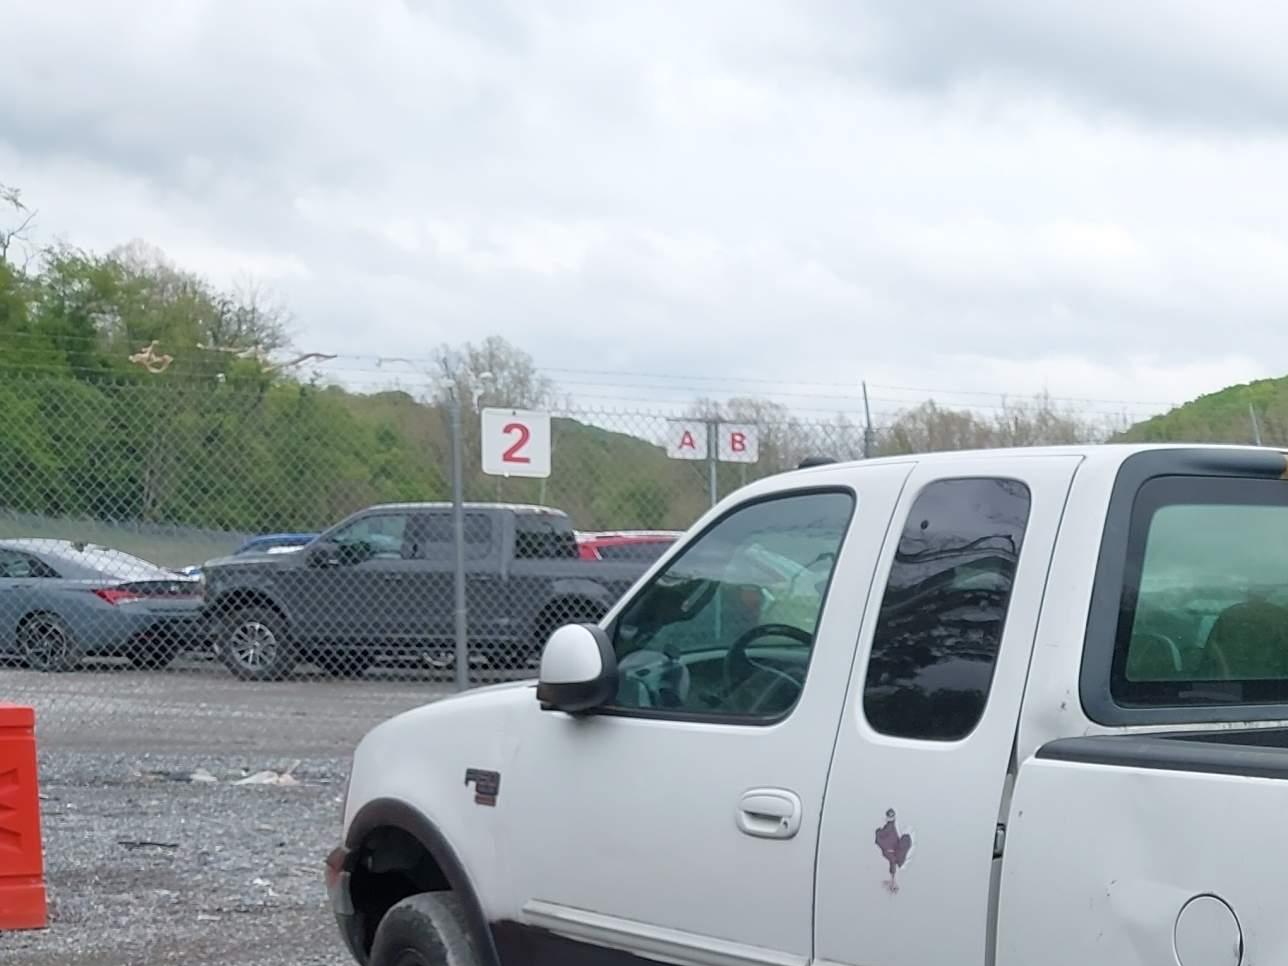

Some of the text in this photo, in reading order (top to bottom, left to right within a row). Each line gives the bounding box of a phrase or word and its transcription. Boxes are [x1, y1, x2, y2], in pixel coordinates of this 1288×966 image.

[503, 423, 530, 464] 2
[679, 430, 696, 450] A
[731, 432, 746, 452] B
